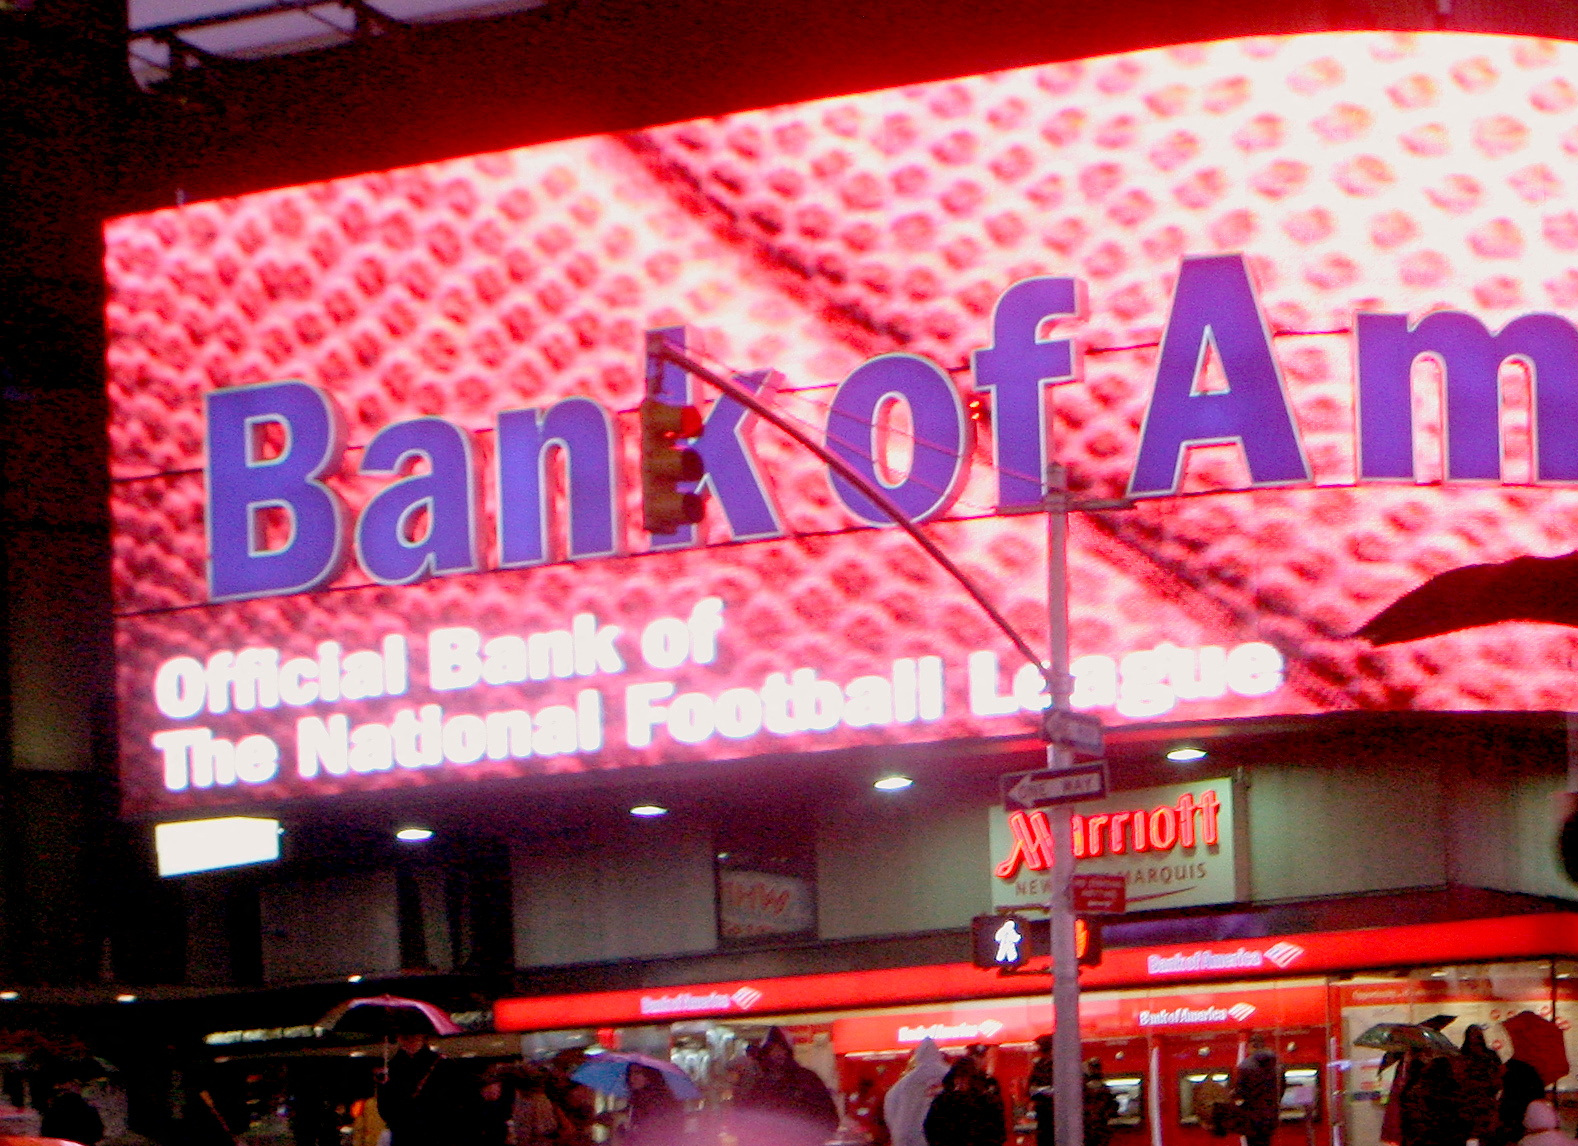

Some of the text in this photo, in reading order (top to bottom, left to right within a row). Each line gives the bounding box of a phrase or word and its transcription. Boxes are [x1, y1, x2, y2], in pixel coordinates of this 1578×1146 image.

[204, 327, 785, 602] Bank
[824, 277, 1084, 529] of
[150, 641, 1286, 792] The National Football League
[154, 597, 725, 719] Official Bank of
